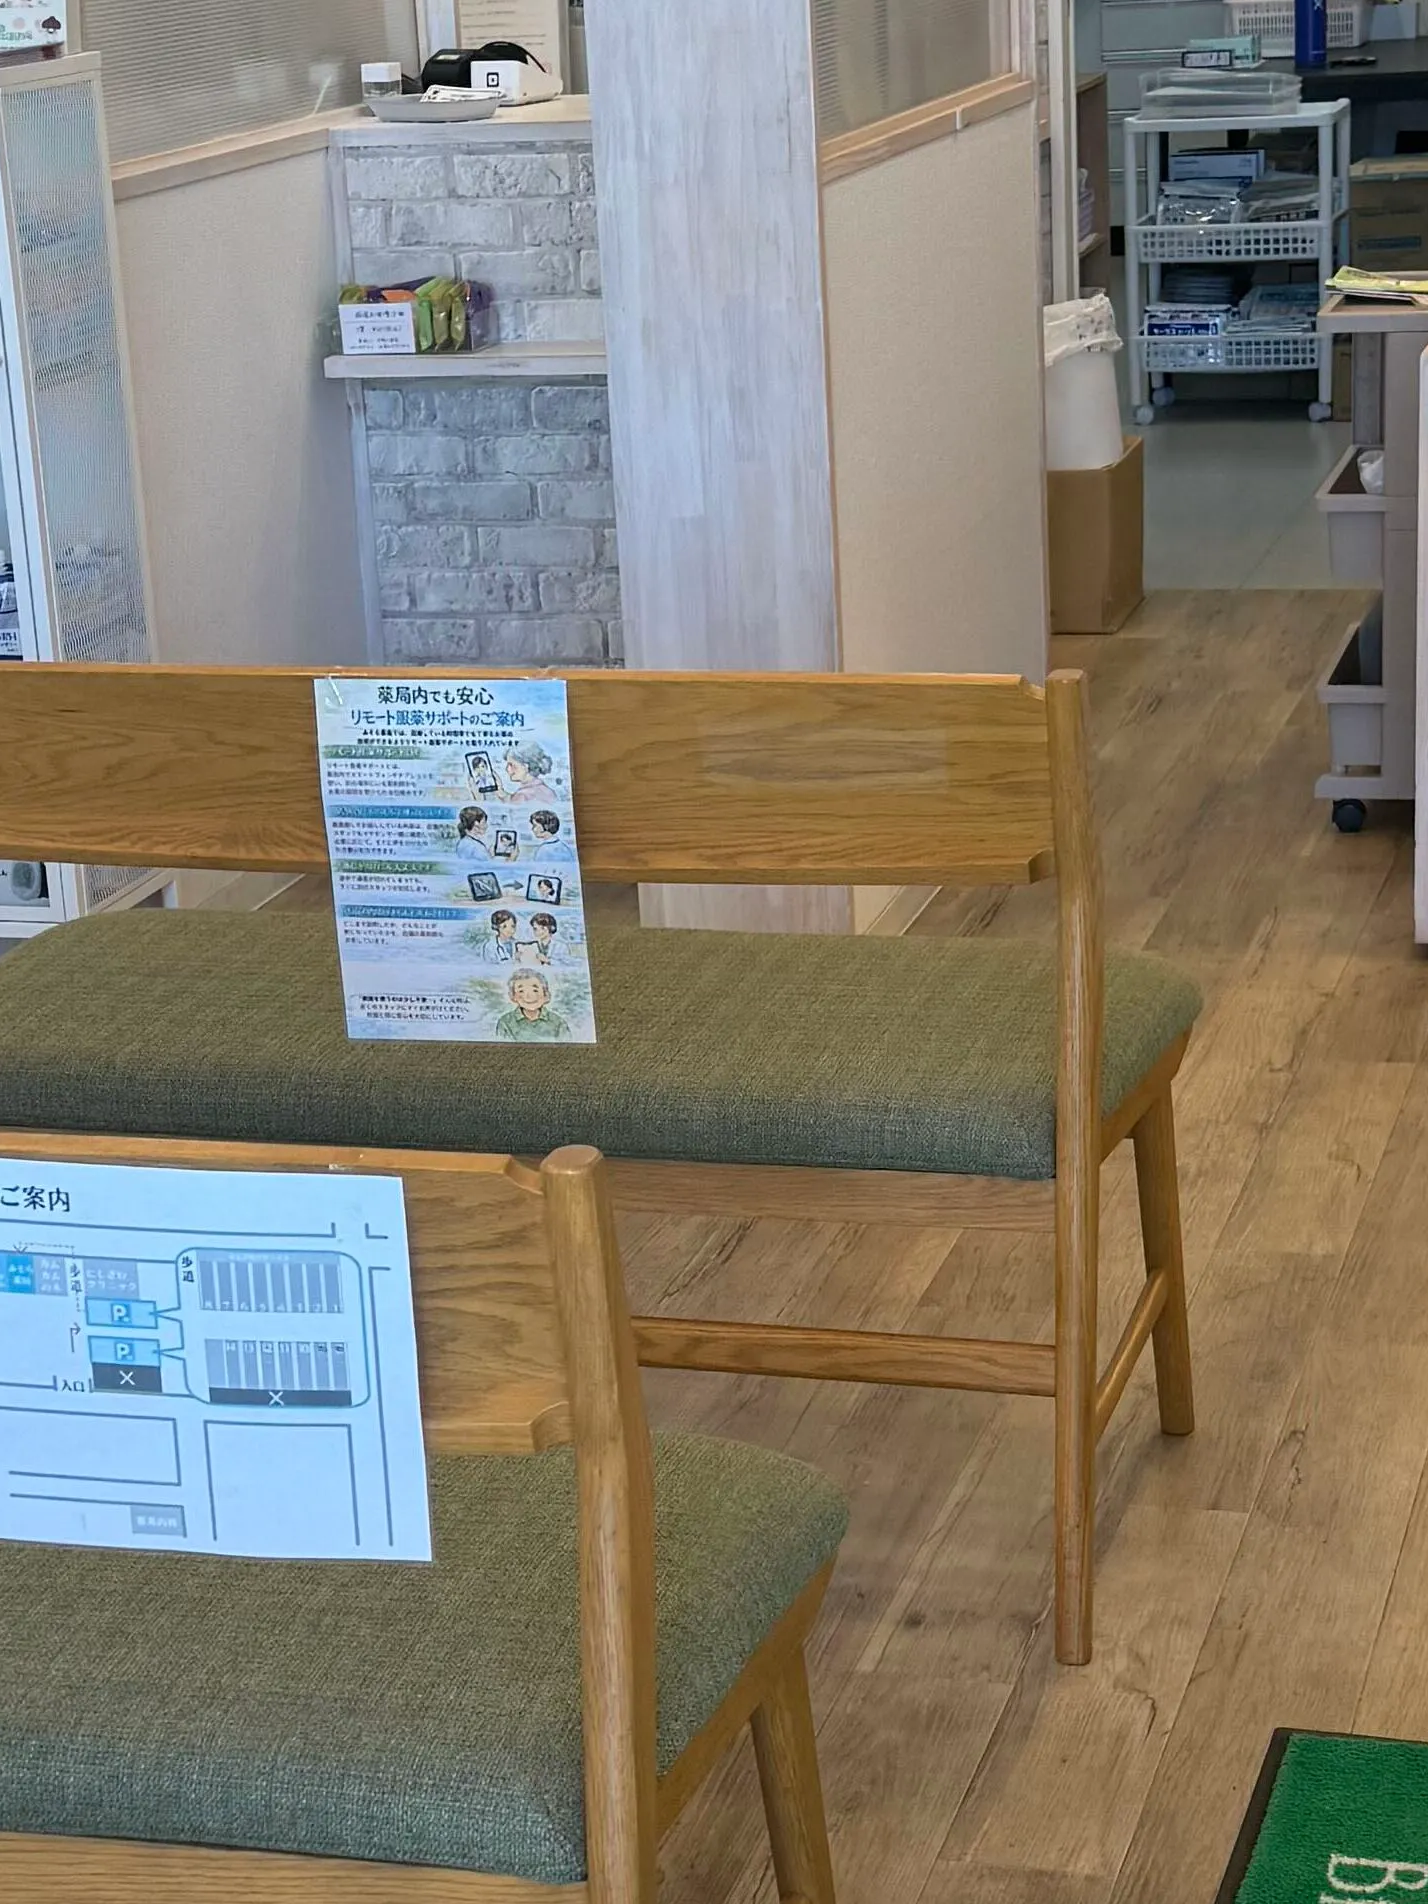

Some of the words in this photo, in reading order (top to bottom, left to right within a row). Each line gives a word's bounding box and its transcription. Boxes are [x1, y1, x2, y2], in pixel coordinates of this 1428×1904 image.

[378, 685, 495, 706] 薬局内でも安心
[351, 709, 525, 727] リモート服薬サポートのご案内
[181, 1255, 195, 1284] 歩道
[60, 1378, 85, 1393] 入口
